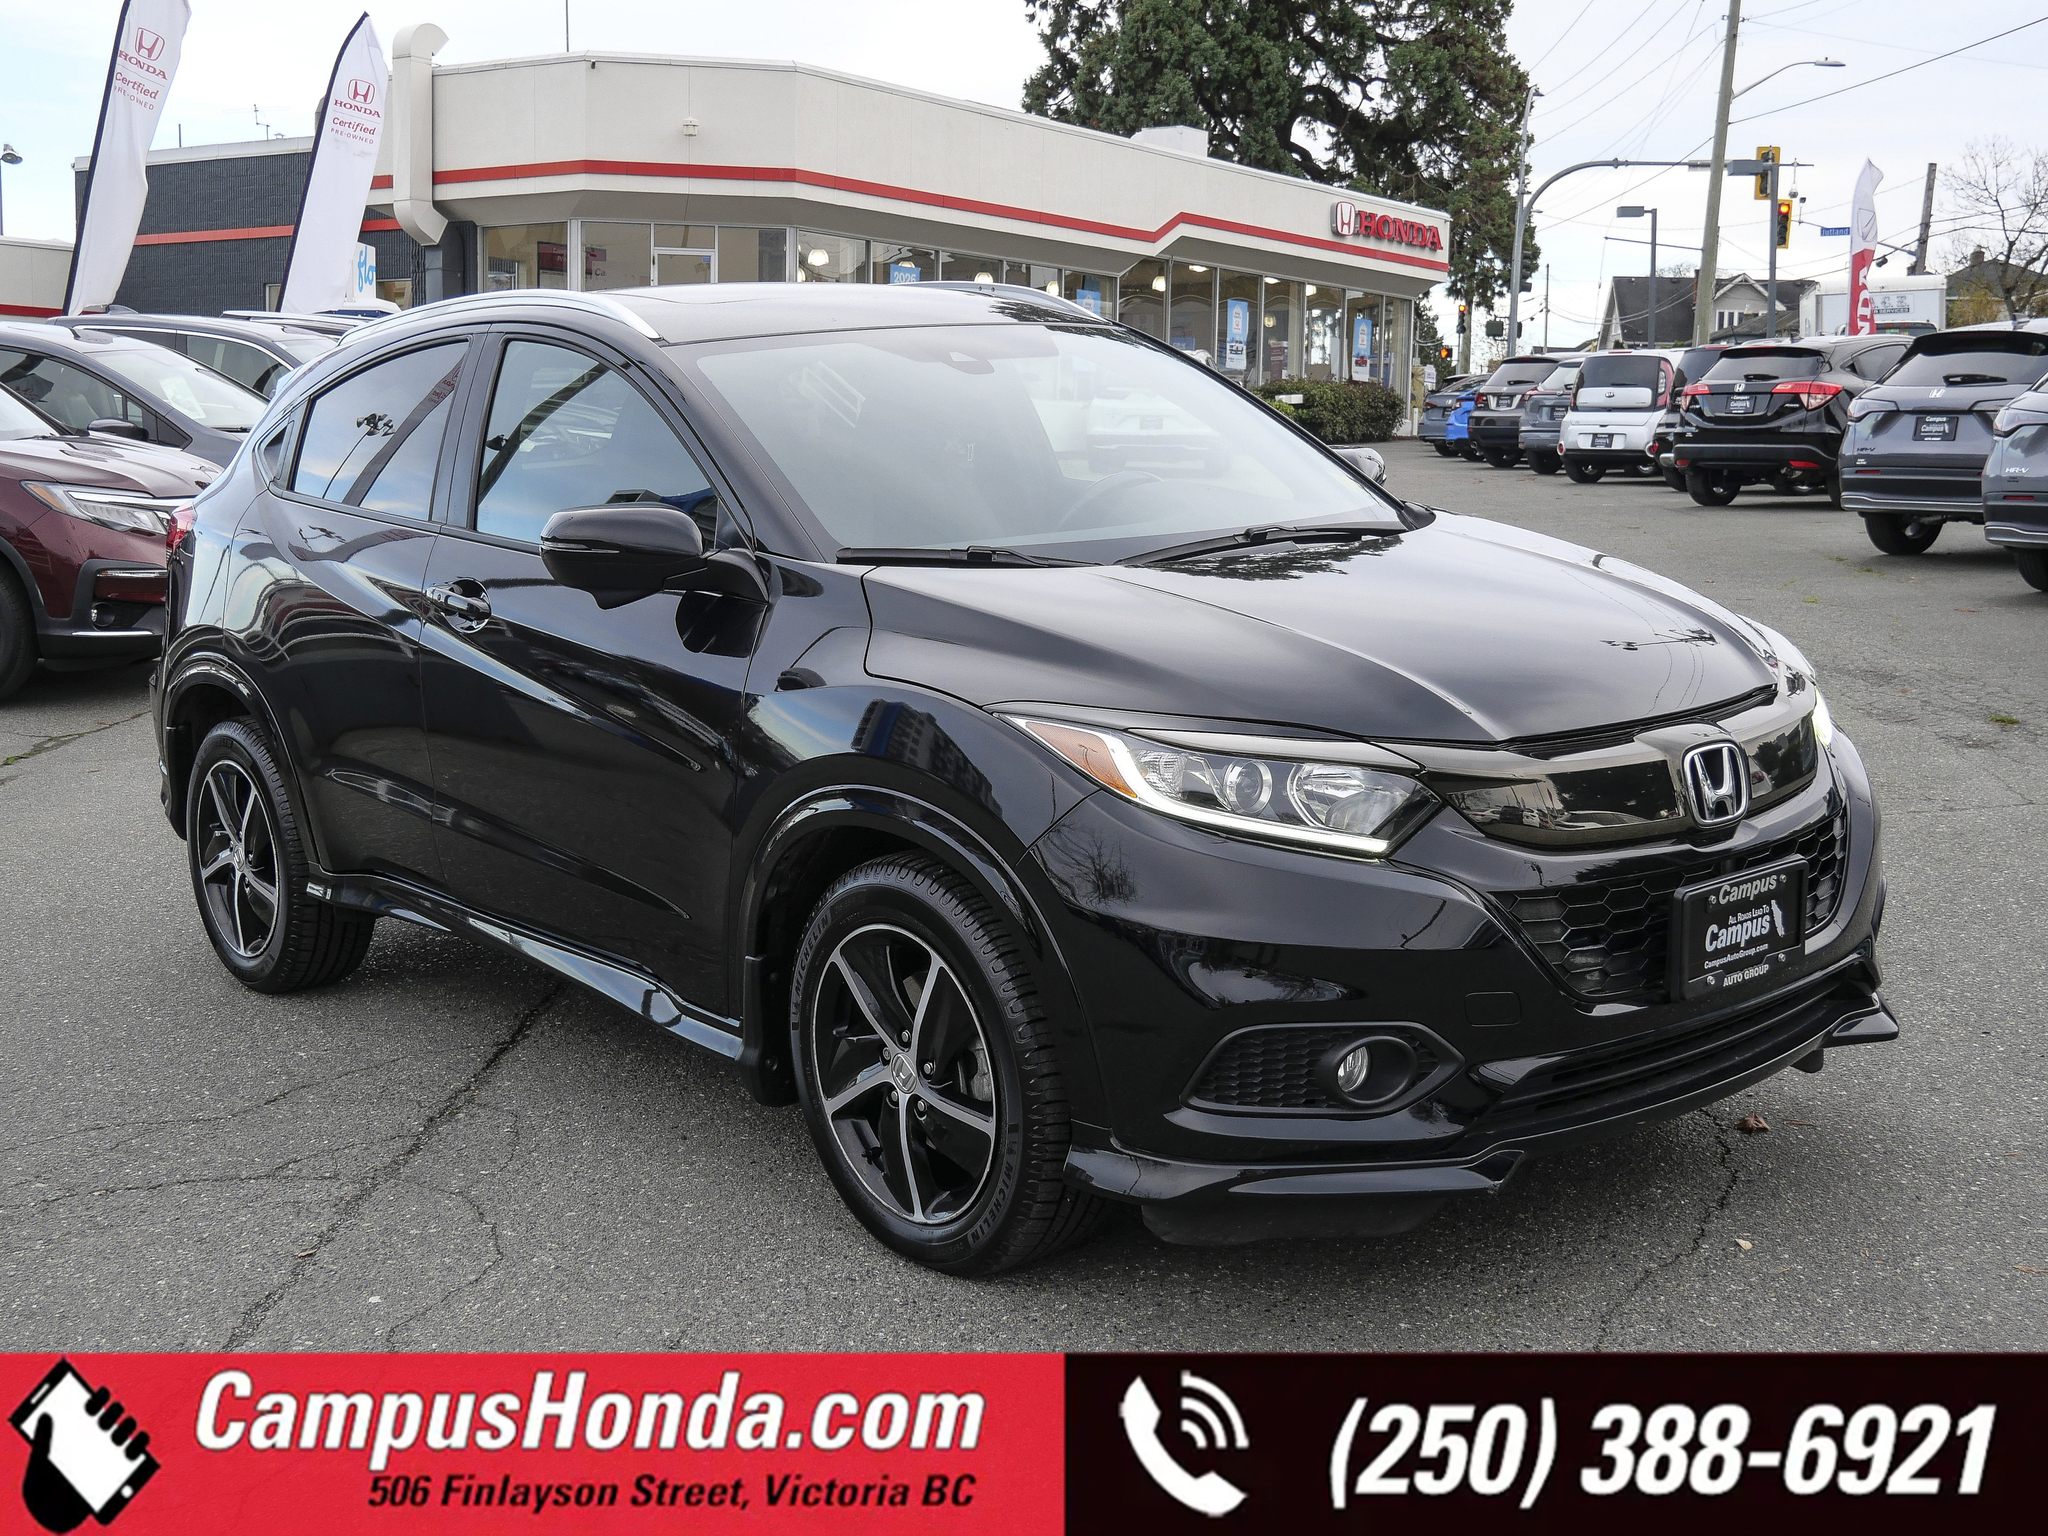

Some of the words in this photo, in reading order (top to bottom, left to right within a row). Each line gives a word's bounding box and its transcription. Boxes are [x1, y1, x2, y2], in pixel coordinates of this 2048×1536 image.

[118, 50, 167, 80] HONDA
[334, 99, 381, 118] HONDA
[331, 128, 374, 144] PRE-OWNED
[332, 117, 376, 135] Certified
[1358, 210, 1443, 250] HONDA
[1822, 228, 1849, 236] Jutland
[1719, 874, 1777, 904] Campus
[1705, 915, 1771, 952] Campus
[795, 914, 829, 997] MICHELIN
[1704, 943, 1769, 969] CampusAutoGroup.com
[1723, 972, 1743, 987] AUTO
[1744, 964, 1769, 980] GROUP
[971, 1161, 1014, 1244] MICHELIN
